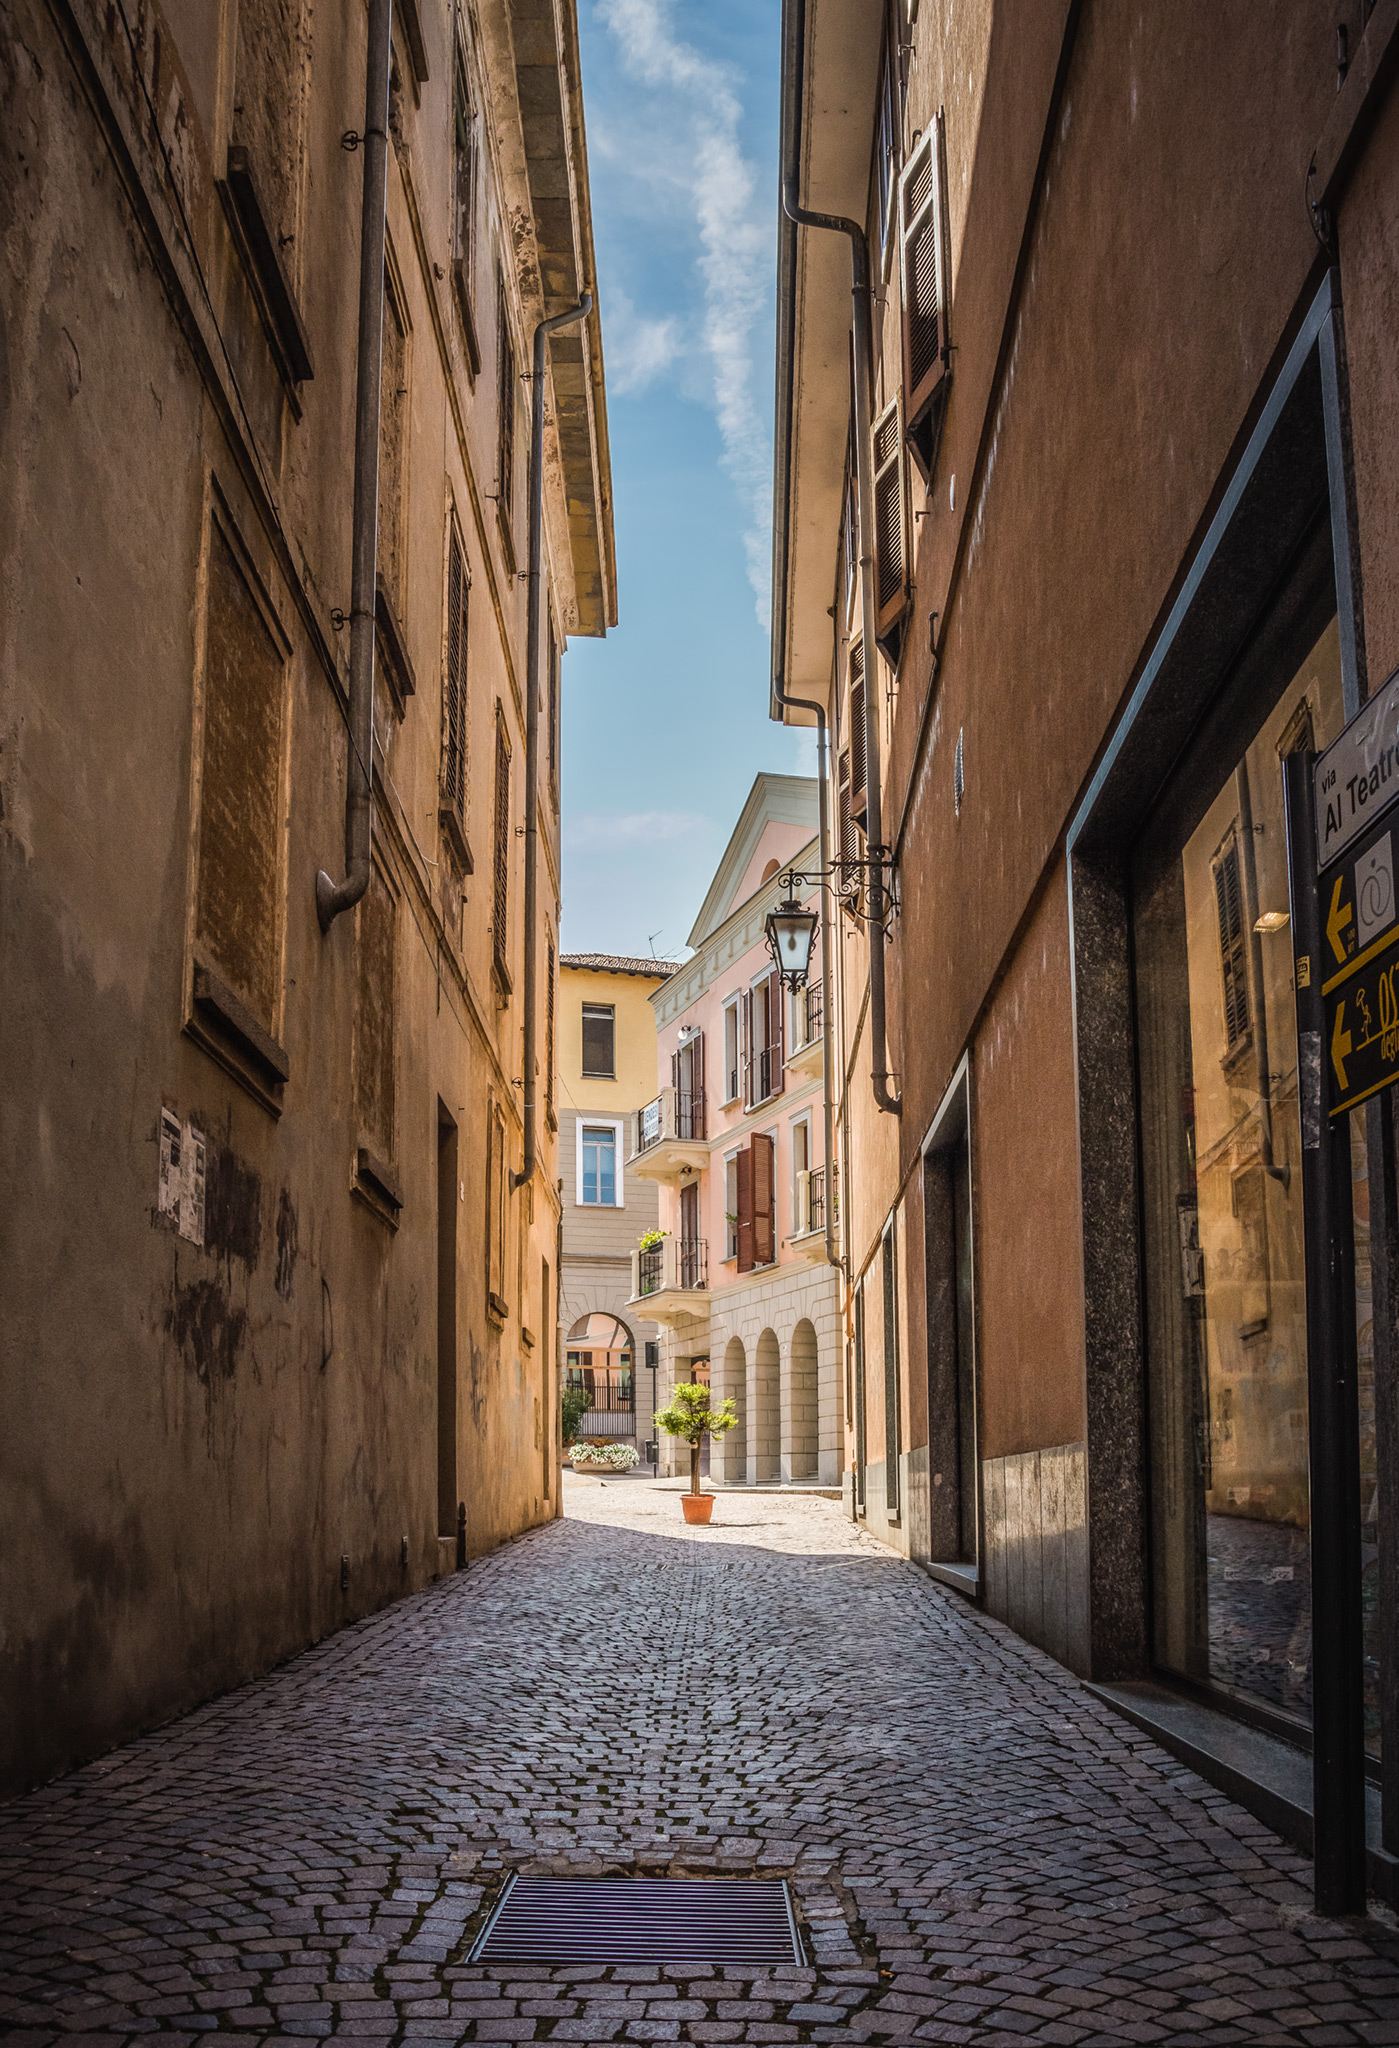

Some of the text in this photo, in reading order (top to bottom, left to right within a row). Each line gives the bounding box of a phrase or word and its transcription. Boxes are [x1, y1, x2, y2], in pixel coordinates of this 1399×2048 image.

[1321, 769, 1337, 795] via
[1325, 792, 1342, 843] Al
[1379, 961, 1399, 1031] OS
